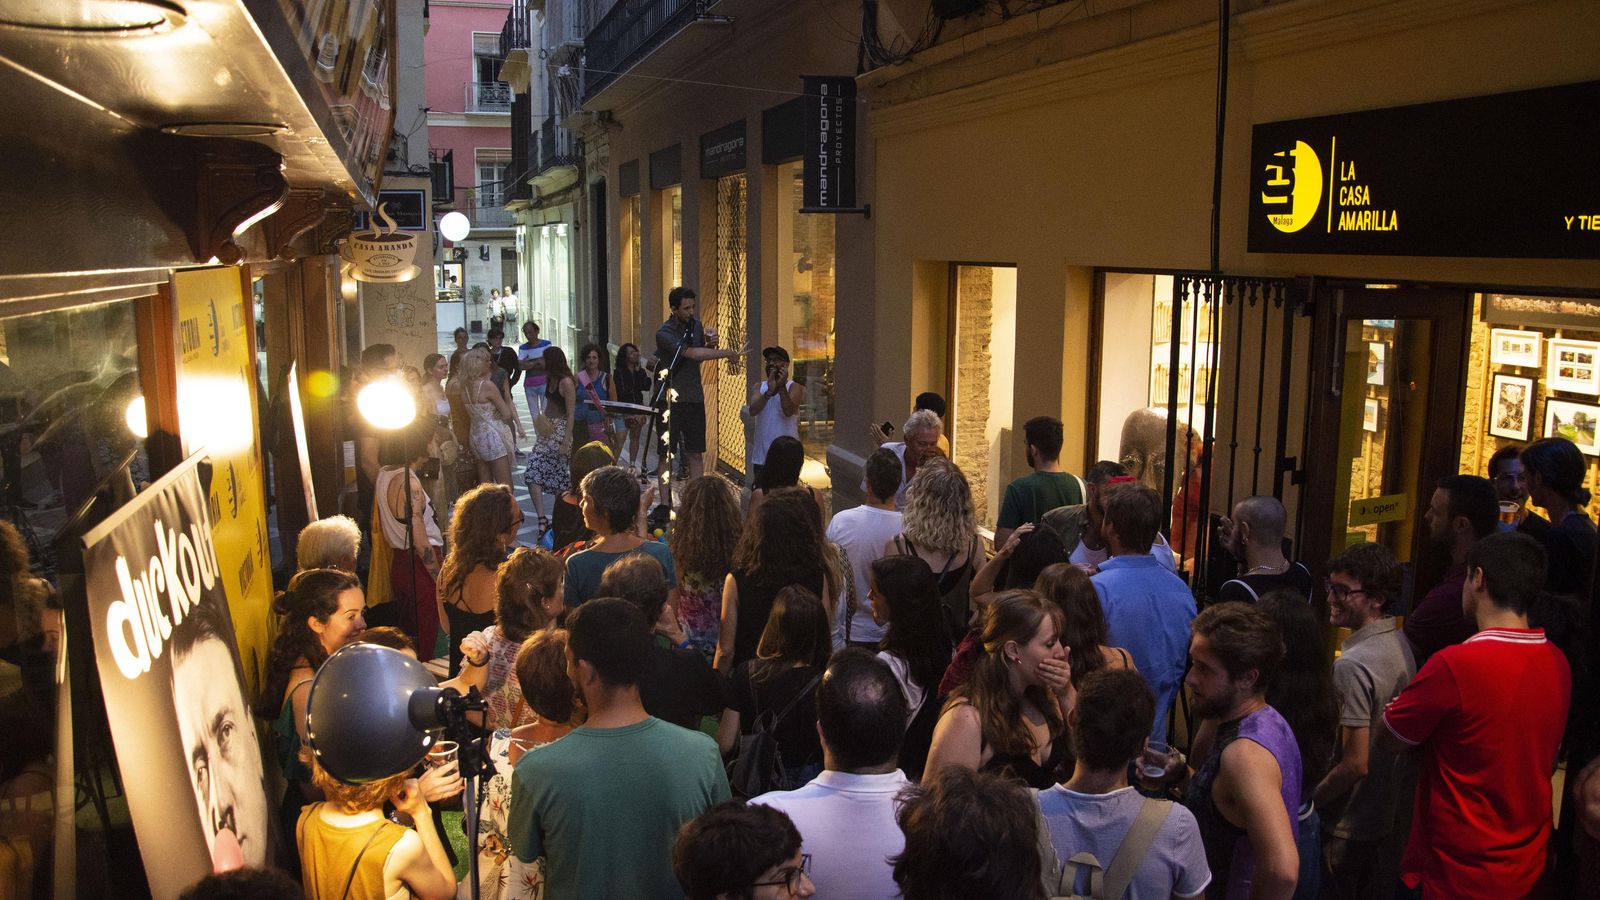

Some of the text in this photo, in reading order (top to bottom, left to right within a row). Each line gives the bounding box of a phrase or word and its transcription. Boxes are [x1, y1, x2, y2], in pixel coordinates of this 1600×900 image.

[820, 84, 829, 206] mandragora
[1340, 160, 1356, 181] LA
[1339, 184, 1370, 206] CASA
[1337, 209, 1398, 231] AMARILLA
[1564, 215, 1575, 230] Y
[353, 241, 414, 252] CASA ARANDA
